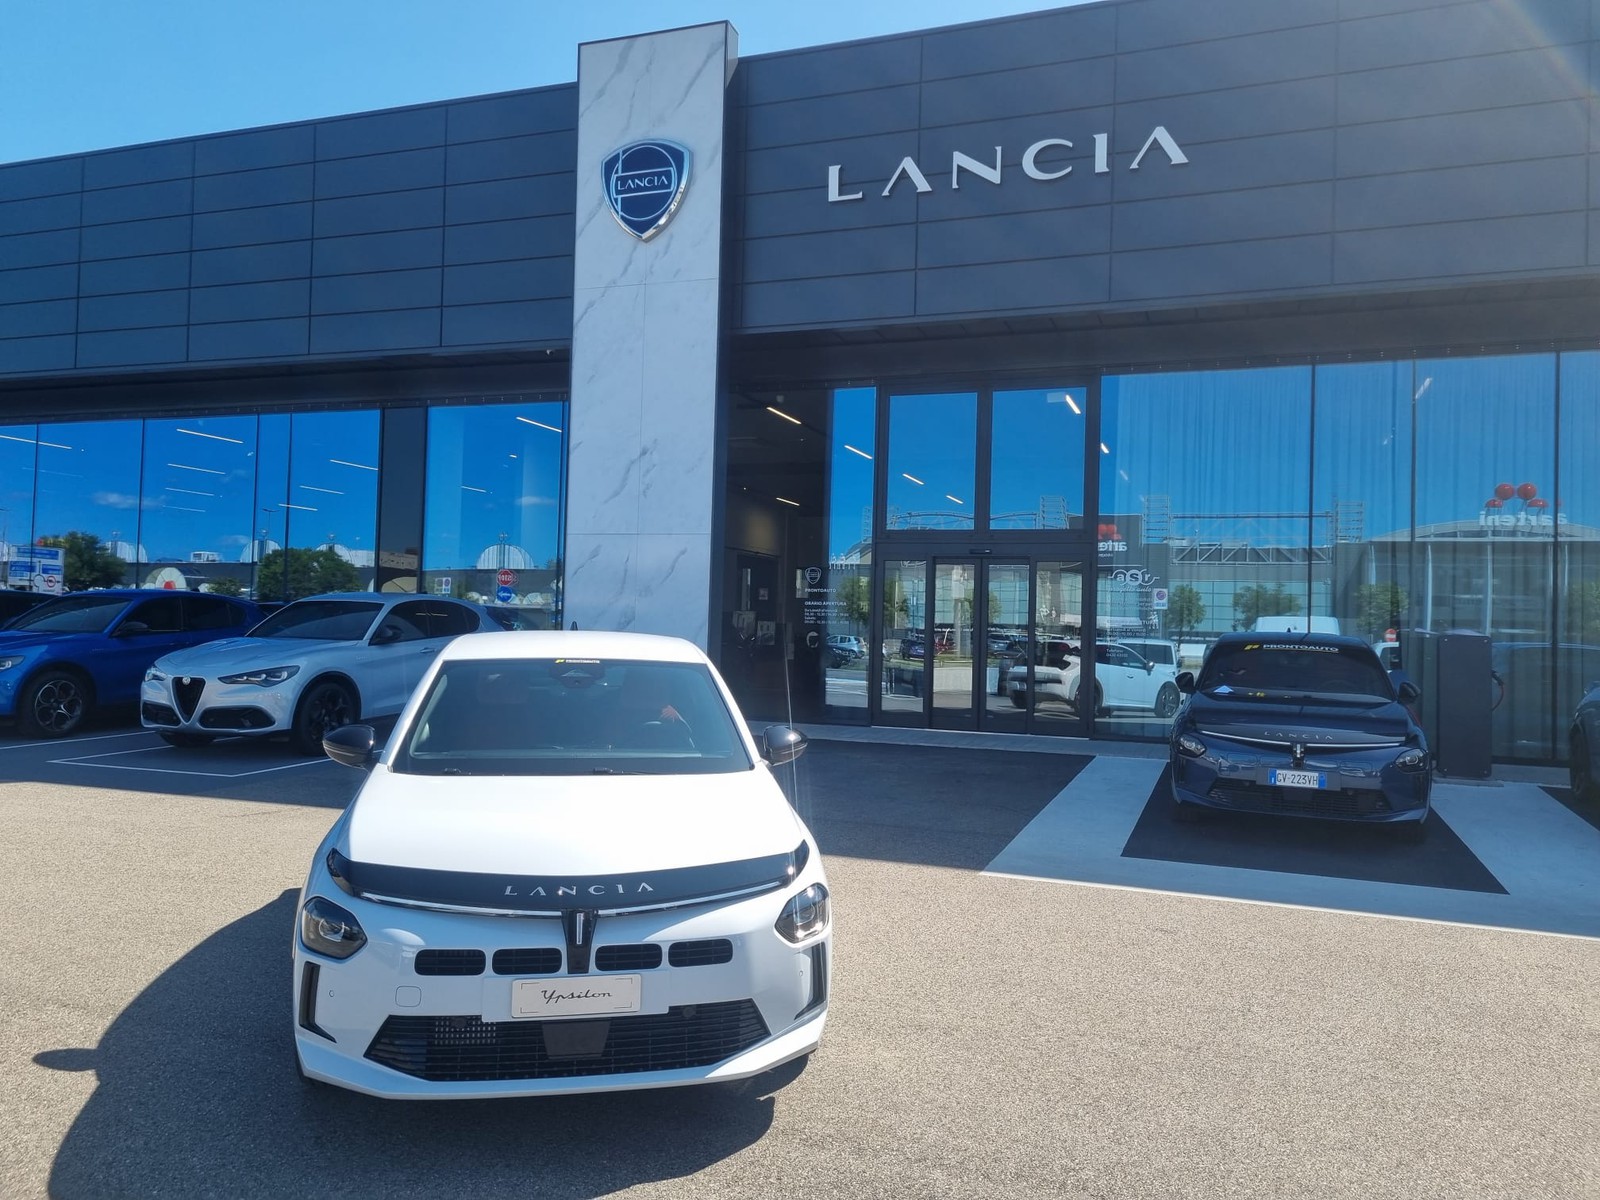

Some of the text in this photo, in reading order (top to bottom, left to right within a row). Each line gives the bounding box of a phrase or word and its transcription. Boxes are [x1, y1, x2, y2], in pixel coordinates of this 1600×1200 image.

[828, 126, 1189, 202] LANCIA
[617, 176, 668, 190] LANCIA
[1263, 644, 1339, 652] PRONTOAUTO
[1264, 731, 1333, 740] LANCIA
[504, 882, 653, 896] LANCIA
[541, 989, 612, 1004] Ypsilon
